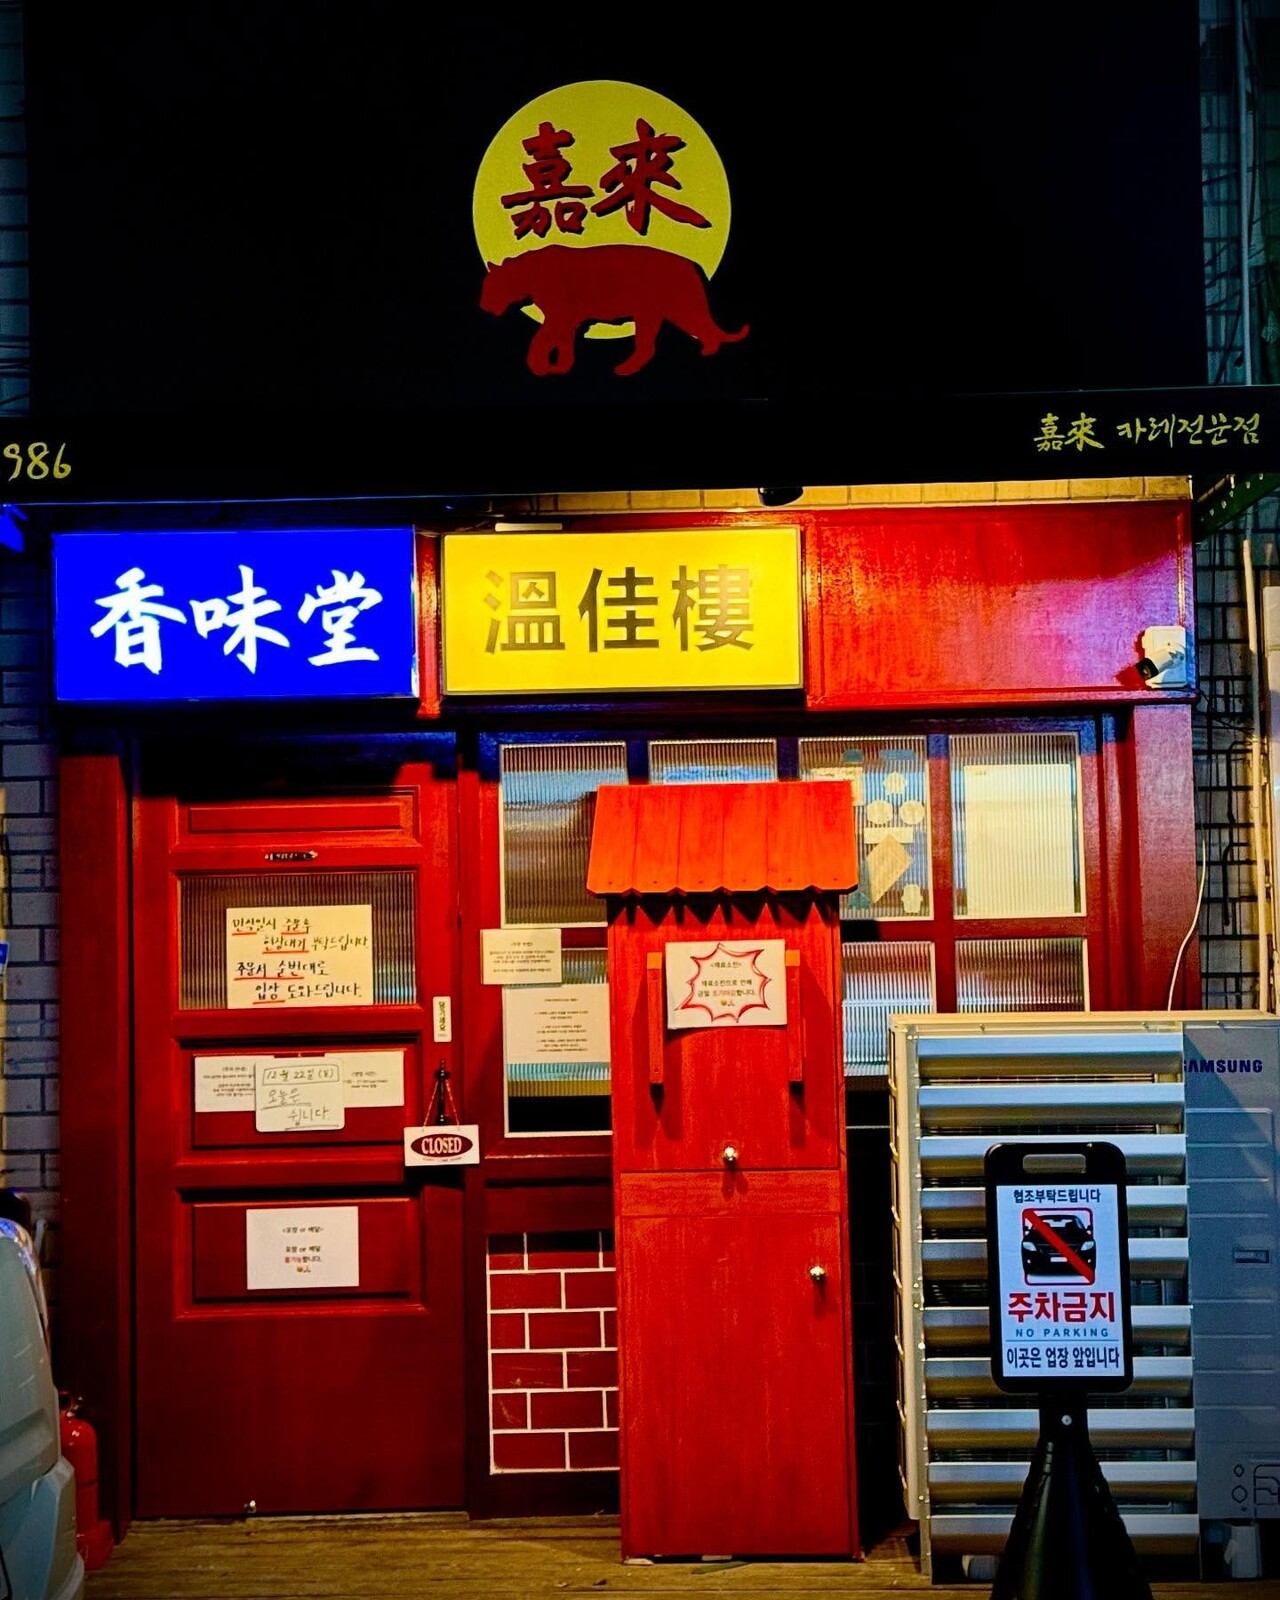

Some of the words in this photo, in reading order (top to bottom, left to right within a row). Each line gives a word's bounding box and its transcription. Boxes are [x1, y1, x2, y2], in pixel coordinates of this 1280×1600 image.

[500, 117, 712, 241] 嘉來
[1033, 412, 1105, 452] 嘉來
[1116, 413, 1260, 448] 카레전문점
[3, 442, 72, 481] 986
[90, 564, 384, 675] 香味堂
[484, 564, 755, 655] 溫佳樓
[255, 982, 280, 1000] 입장
[268, 1088, 300, 1105] 오늘은
[421, 1136, 463, 1154] CLOSED
[1013, 1188, 1101, 1204] 협조부탁드립니다
[1008, 1291, 1115, 1323] 주차금지
[1016, 1328, 1034, 1338] NO
[1044, 1327, 1109, 1338] PARKING
[1007, 1347, 1042, 1369] 이곳은
[1046, 1347, 1069, 1369] 업장
[1072, 1347, 1120, 1369] 앞입니다
